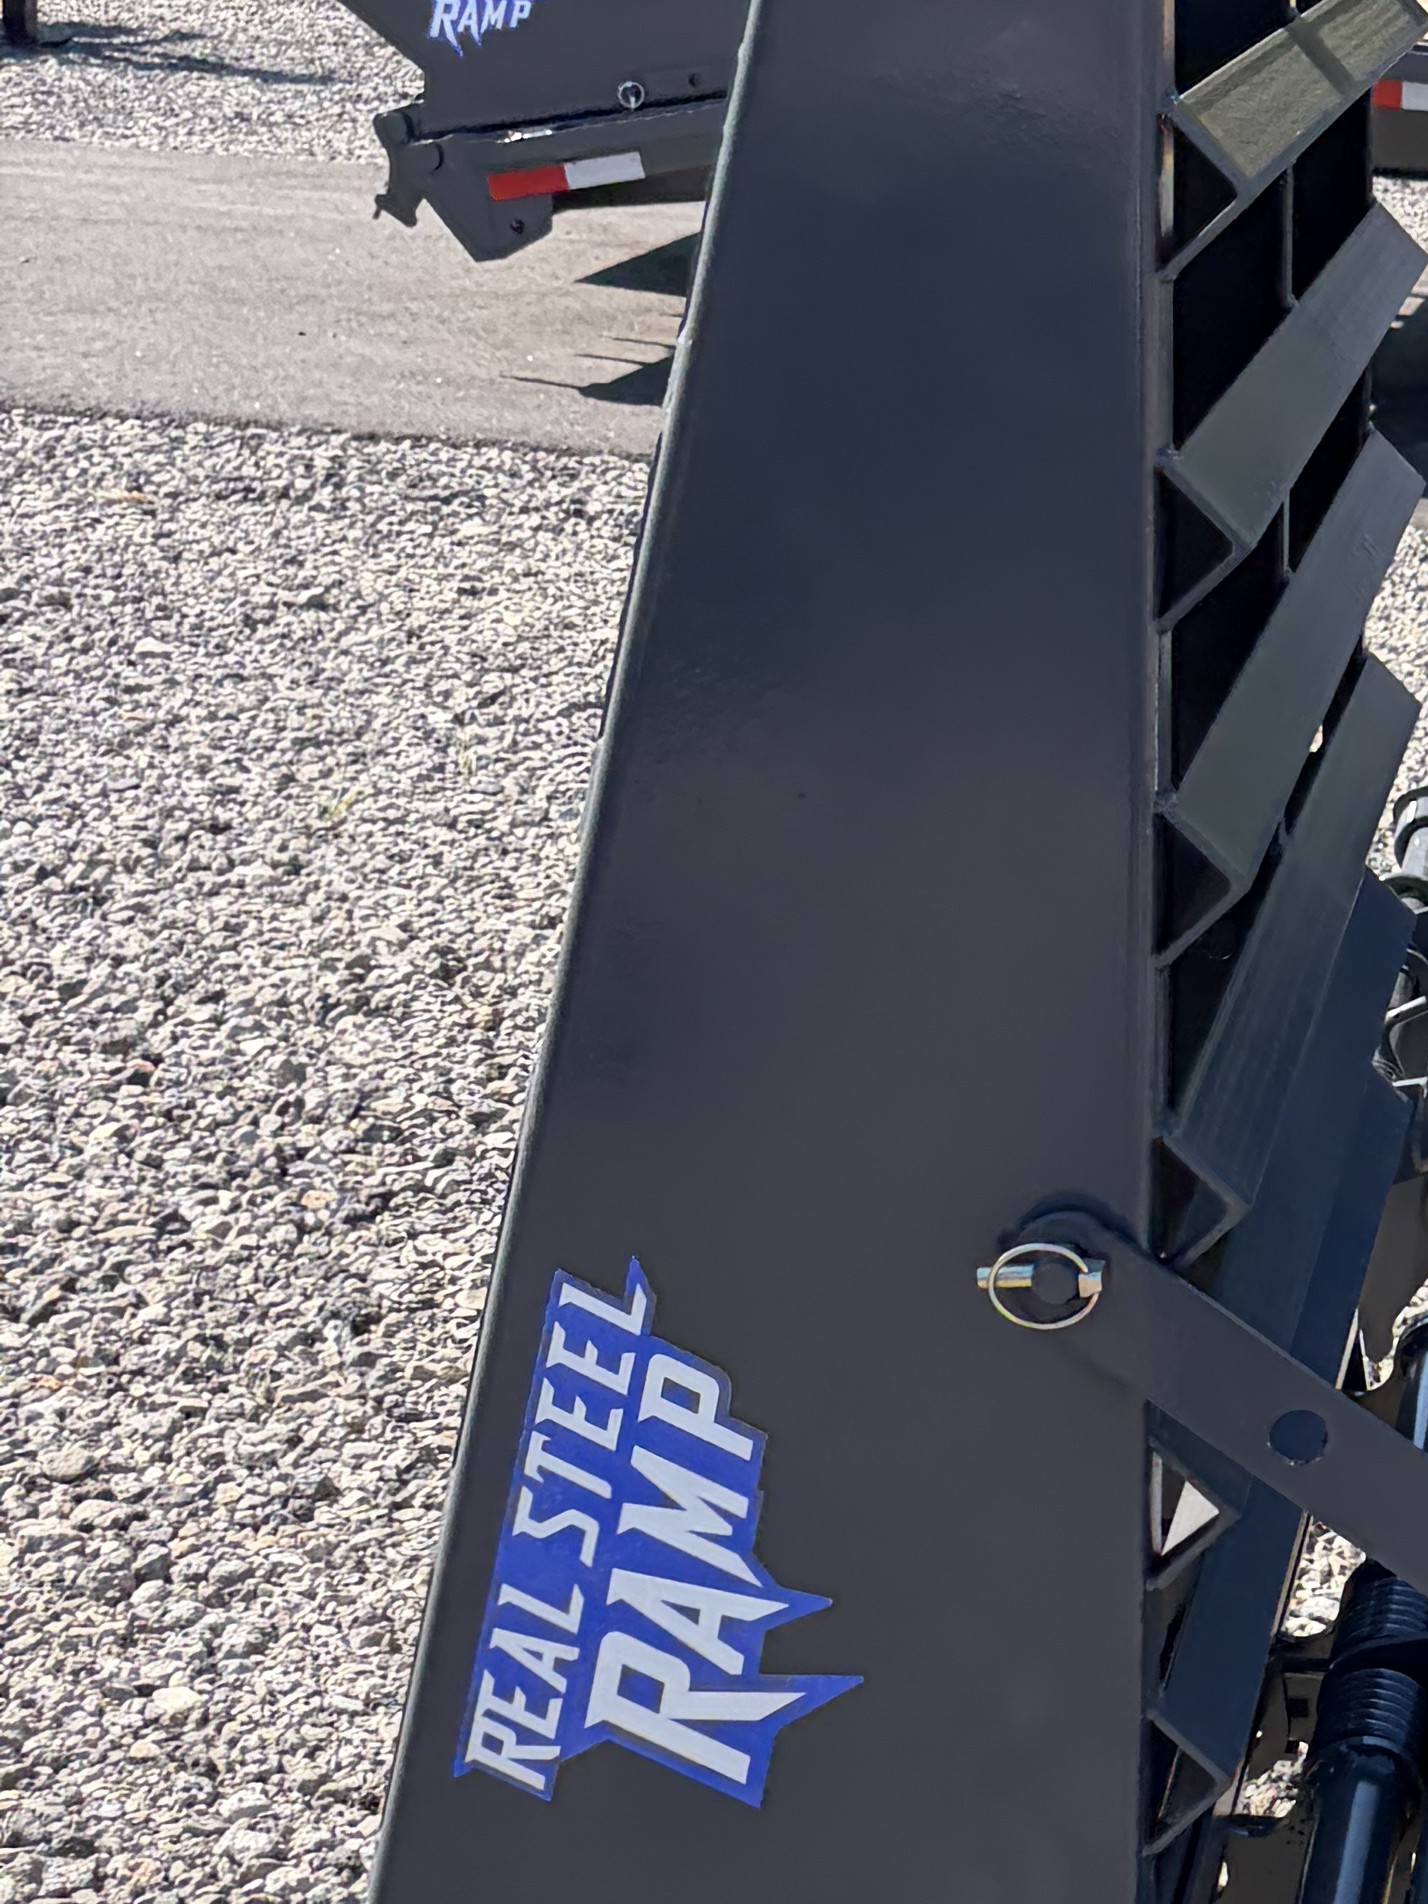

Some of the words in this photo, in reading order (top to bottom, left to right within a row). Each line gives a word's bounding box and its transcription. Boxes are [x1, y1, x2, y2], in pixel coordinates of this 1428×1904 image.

[512, 1282, 648, 1568] STEEL
[464, 1582, 585, 1791] REAL
[584, 1352, 807, 1786] RAMP
